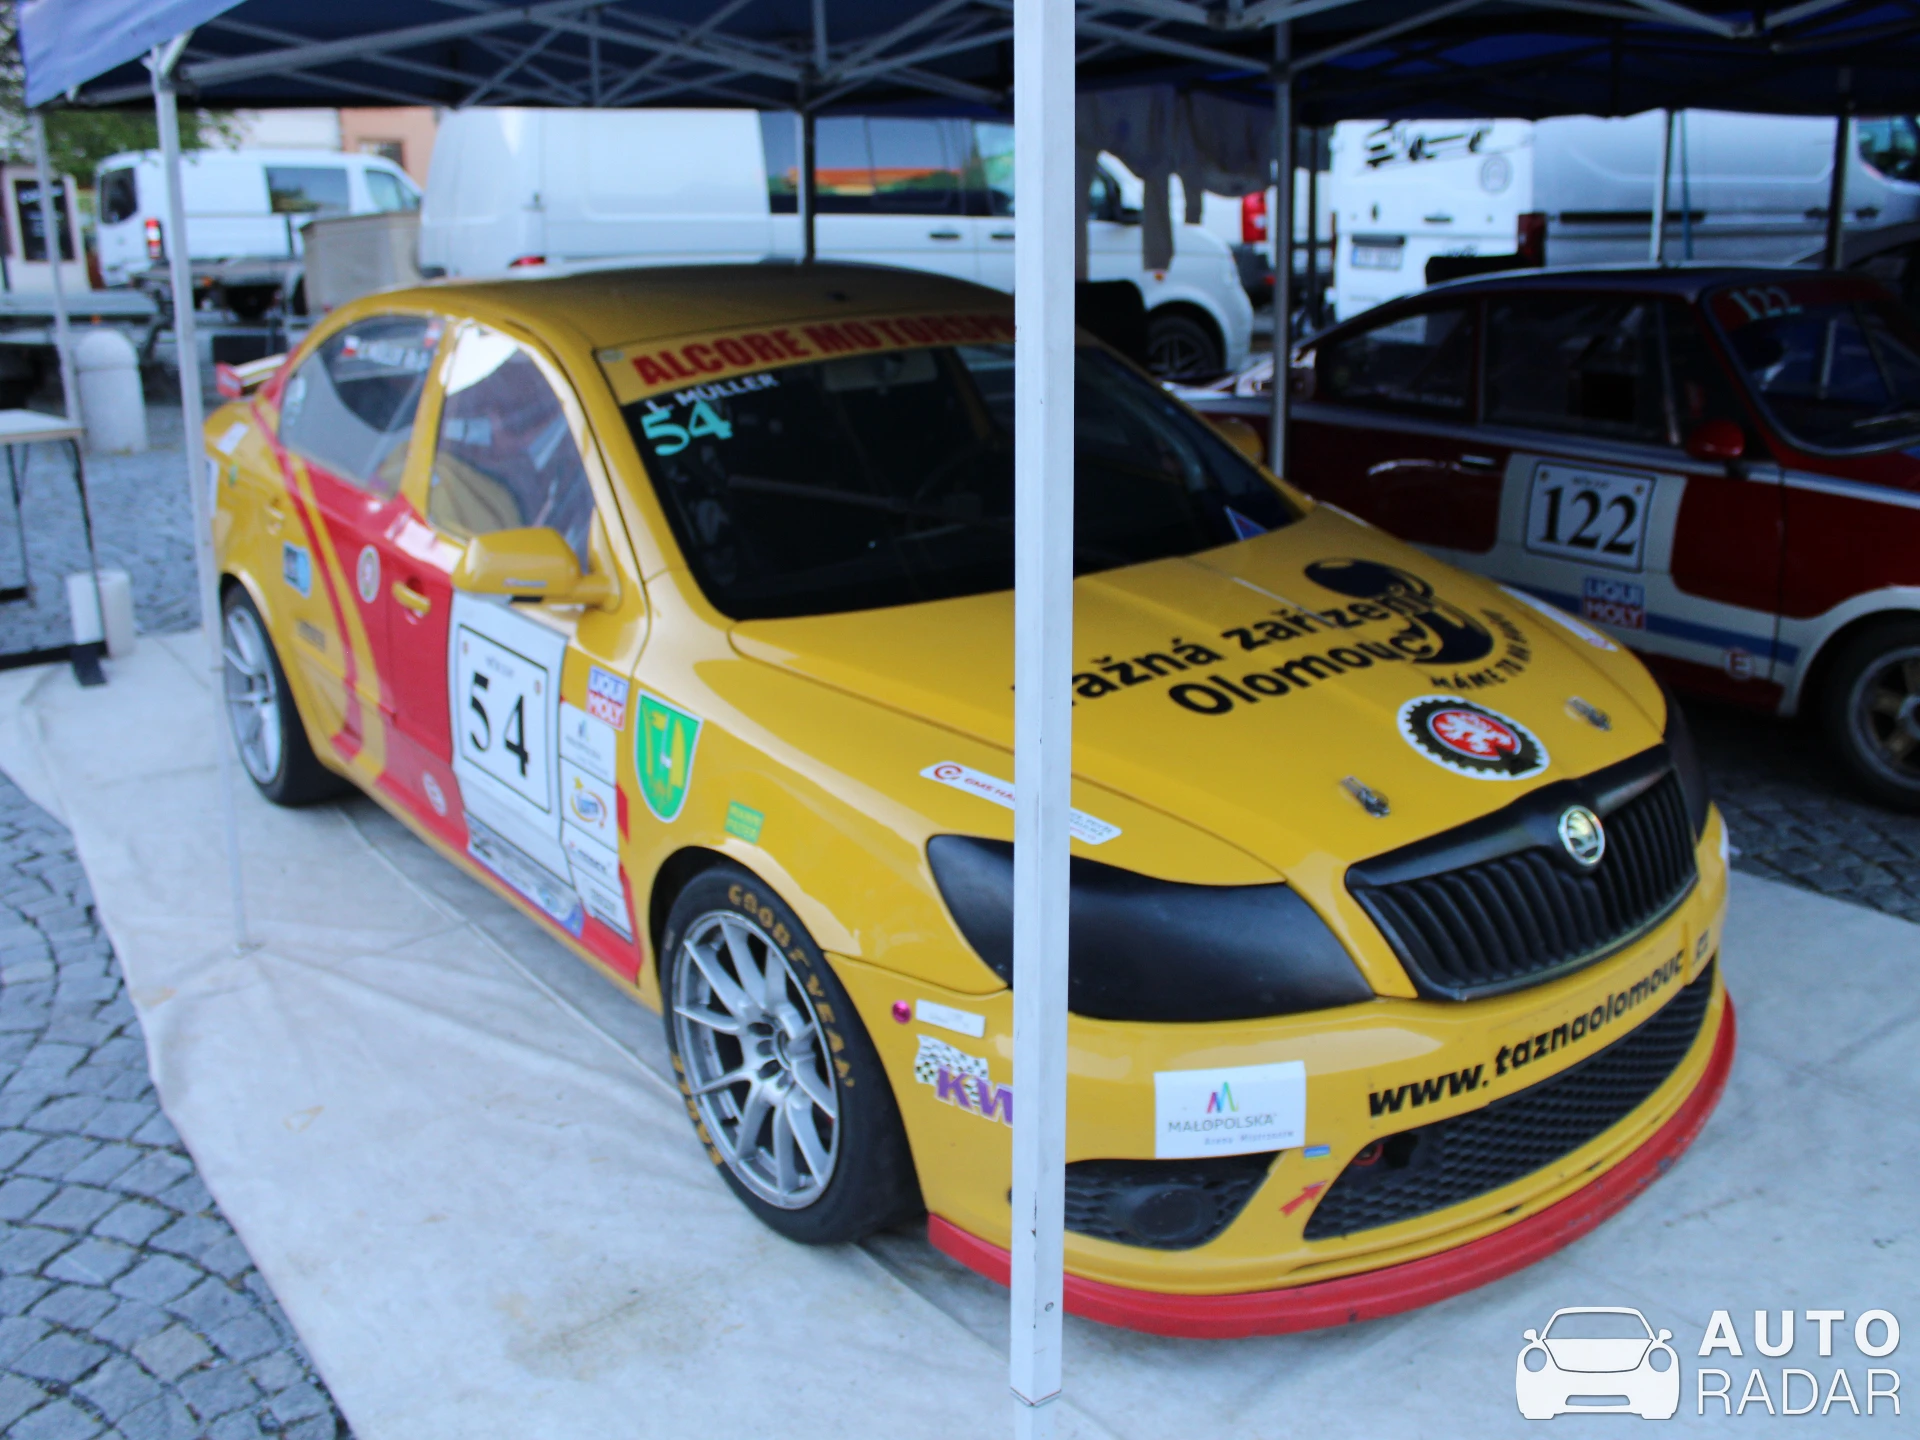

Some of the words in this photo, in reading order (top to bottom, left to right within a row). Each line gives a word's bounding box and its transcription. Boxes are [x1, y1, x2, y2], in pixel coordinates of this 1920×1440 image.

[631, 327, 812, 386] ALCORE
[640, 400, 733, 456] 54
[1540, 485, 1638, 556] 122
[1072, 637, 1226, 704] ažná
[1168, 632, 1433, 716] Olomouc
[469, 671, 529, 778] 54
[1168, 1113, 1274, 1133] MAŁOPOLSKA
